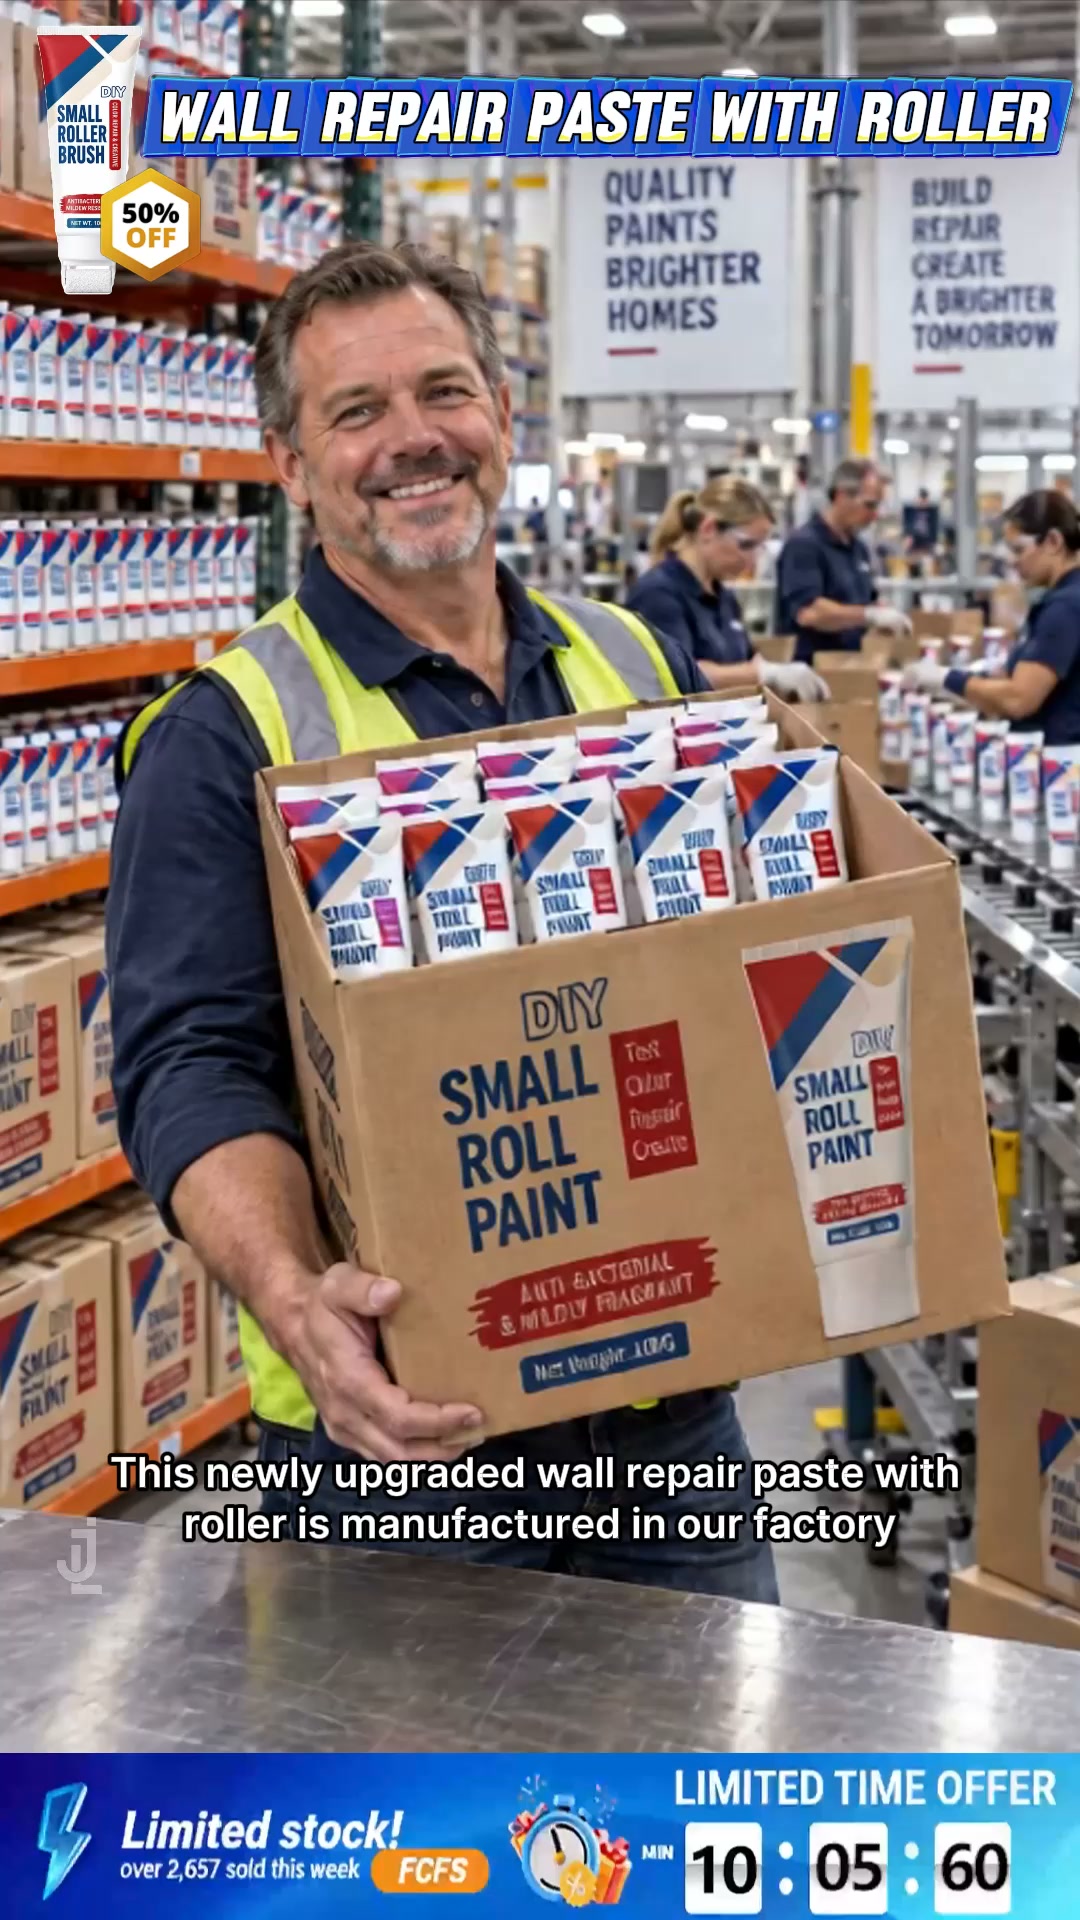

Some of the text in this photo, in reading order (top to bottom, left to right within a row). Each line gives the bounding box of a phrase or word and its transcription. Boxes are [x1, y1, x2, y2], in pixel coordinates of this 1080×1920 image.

[604, 166, 736, 202] QUALITY
[911, 178, 993, 207] BUILD
[605, 209, 718, 247] PAINTS
[911, 214, 1000, 244] REPAIR
[605, 252, 761, 290] BRIGHTER
[911, 250, 1006, 281] CREATE
[607, 297, 718, 332] HOMES
[911, 285, 1056, 317] A BRIGHTER
[913, 321, 1058, 351] TOMORROW
[520, 977, 608, 1042] DIY
[439, 1044, 599, 1125] SMALL
[794, 1063, 868, 1105] SMALL
[804, 1100, 862, 1136] ROLL
[457, 1115, 578, 1189] ROLL
[807, 1128, 875, 1171] PAINT
[465, 1170, 602, 1254] PAINT
